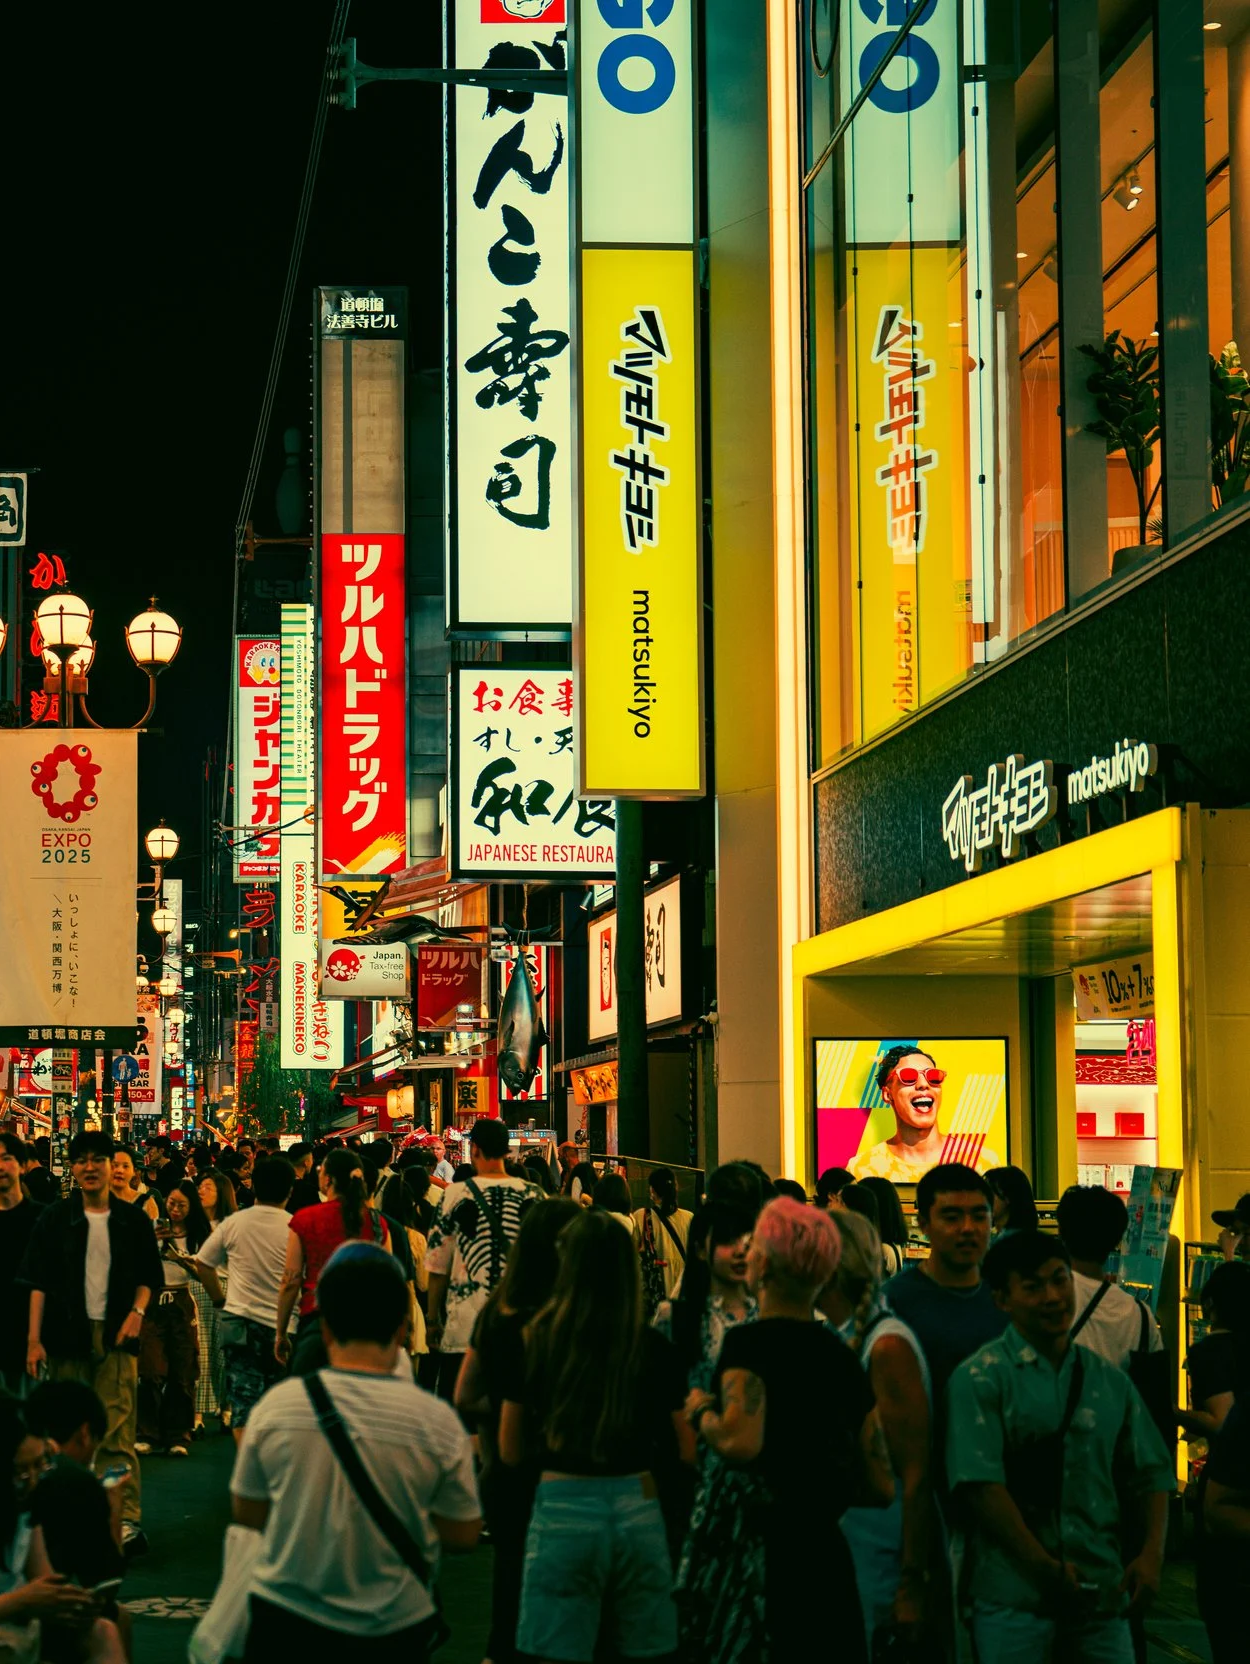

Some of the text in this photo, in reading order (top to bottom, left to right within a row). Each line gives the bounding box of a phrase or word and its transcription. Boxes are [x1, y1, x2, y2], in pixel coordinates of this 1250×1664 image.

[327, 314, 399, 329] 法善寺ビル
[611, 308, 669, 551] マツモトキヨシ
[627, 590, 657, 738] matsukiyo
[339, 544, 388, 832] ツルハドラッグ
[1068, 738, 1150, 805] matsukiyo
[41, 833, 92, 848] EXPO
[41, 849, 92, 863] 2025
[467, 844, 615, 863] JAPANESE RESTAURA
[294, 864, 306, 933] KARAOKE
[373, 951, 404, 962] Japan.
[421, 951, 479, 970] ツルハ
[369, 962, 404, 970] Tax-free
[382, 972, 404, 981] Shop
[421, 973, 469, 987] ドラッグ
[294, 963, 306, 1054] MANEKINEKO
[28, 1029, 106, 1041] 道頓堀商店会
[130, 1080, 149, 1088] BAR
[457, 1080, 478, 1109] 薬
